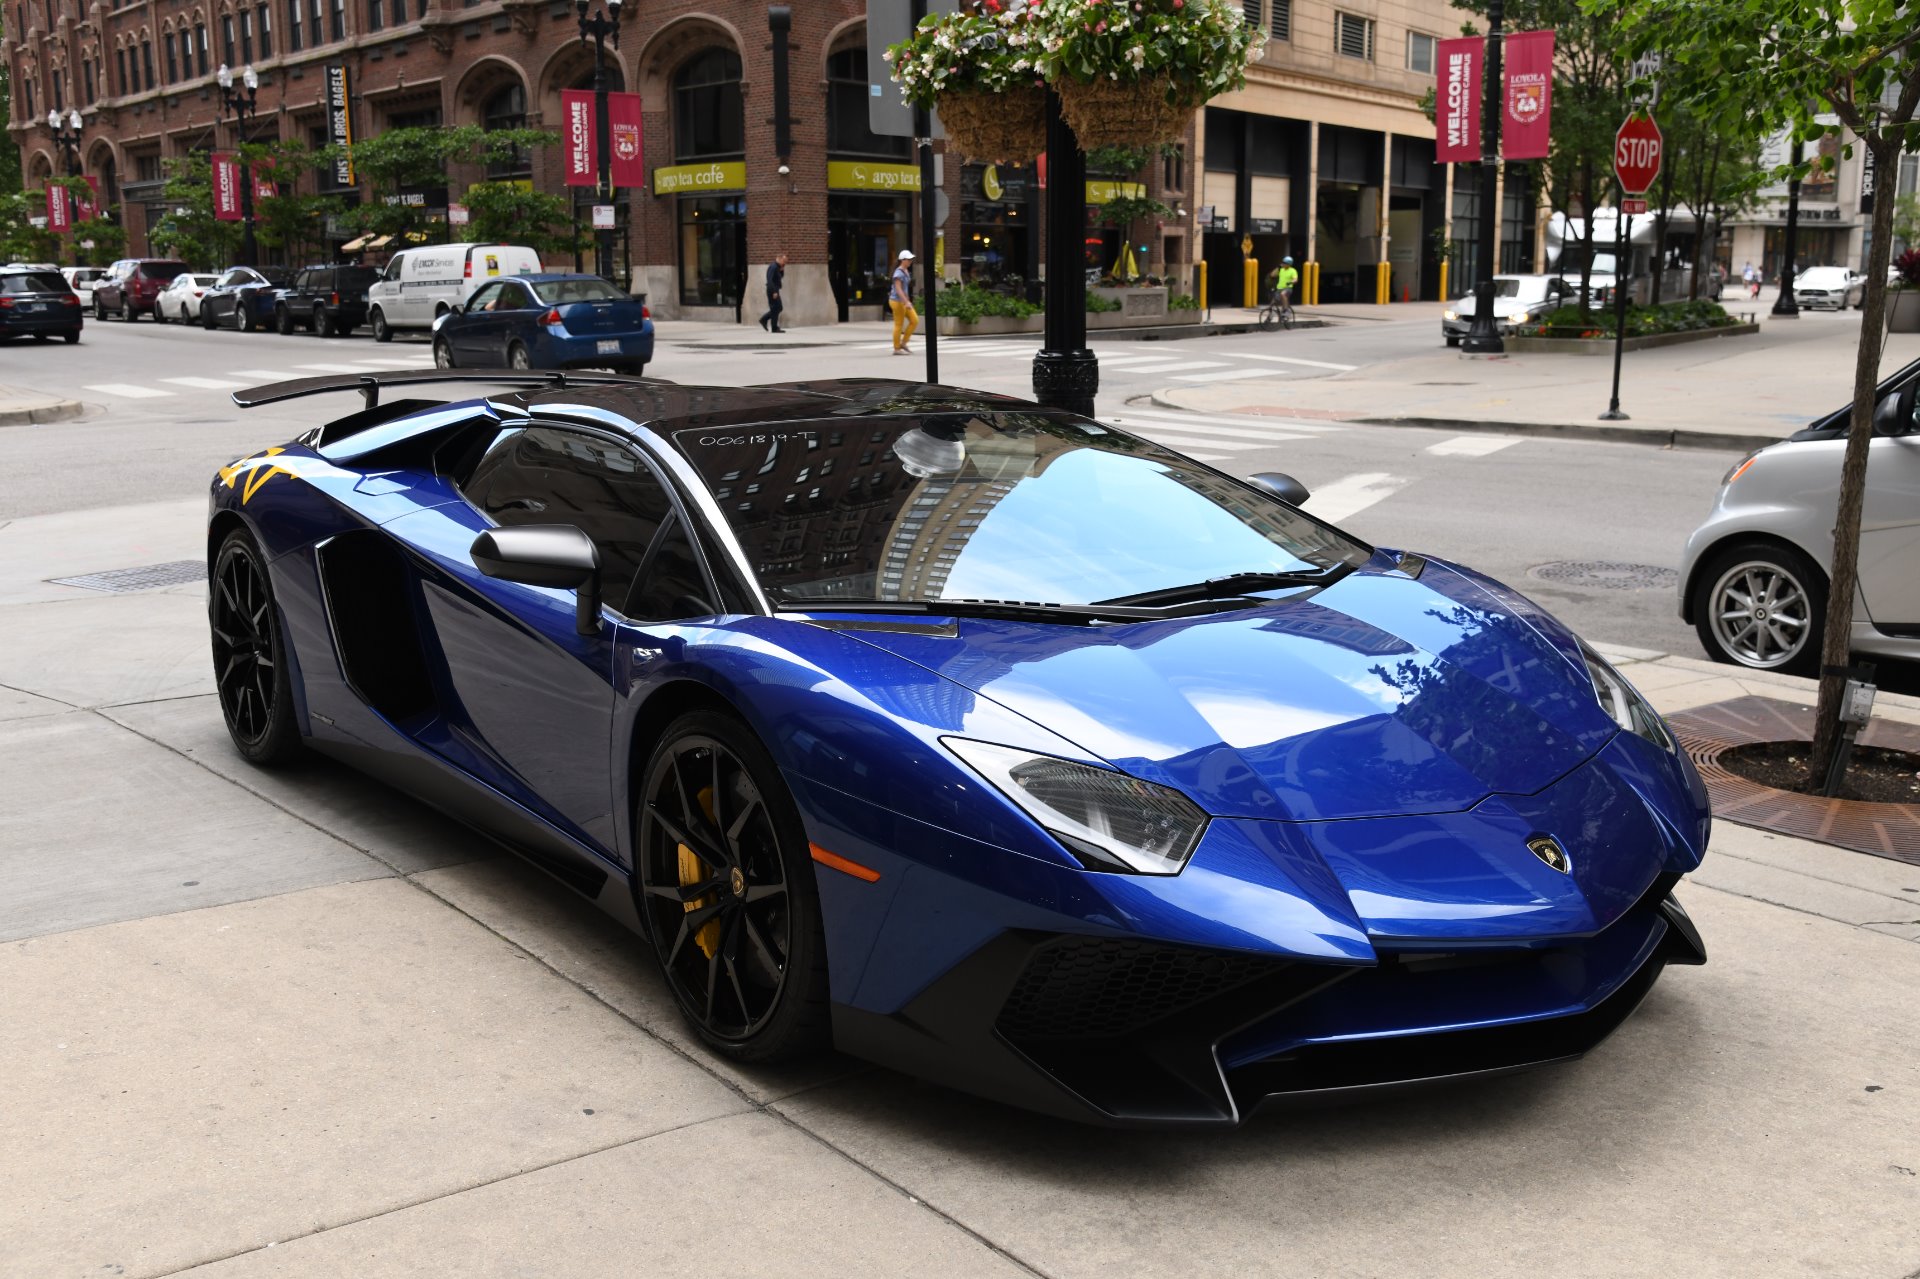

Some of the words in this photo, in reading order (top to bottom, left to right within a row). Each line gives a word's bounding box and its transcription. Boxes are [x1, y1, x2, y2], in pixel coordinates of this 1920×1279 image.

[331, 68, 344, 107] BAGELS
[1510, 73, 1546, 84] LOYOLA
[1447, 53, 1463, 147] WELCOME
[571, 102, 583, 174] WELCOME
[1618, 137, 1659, 169] STOP
[219, 162, 231, 212] WELCOME
[679, 172, 693, 186] tea
[695, 164, 725, 185] café
[872, 171, 899, 189] argo
[901, 170, 914, 185] tea
